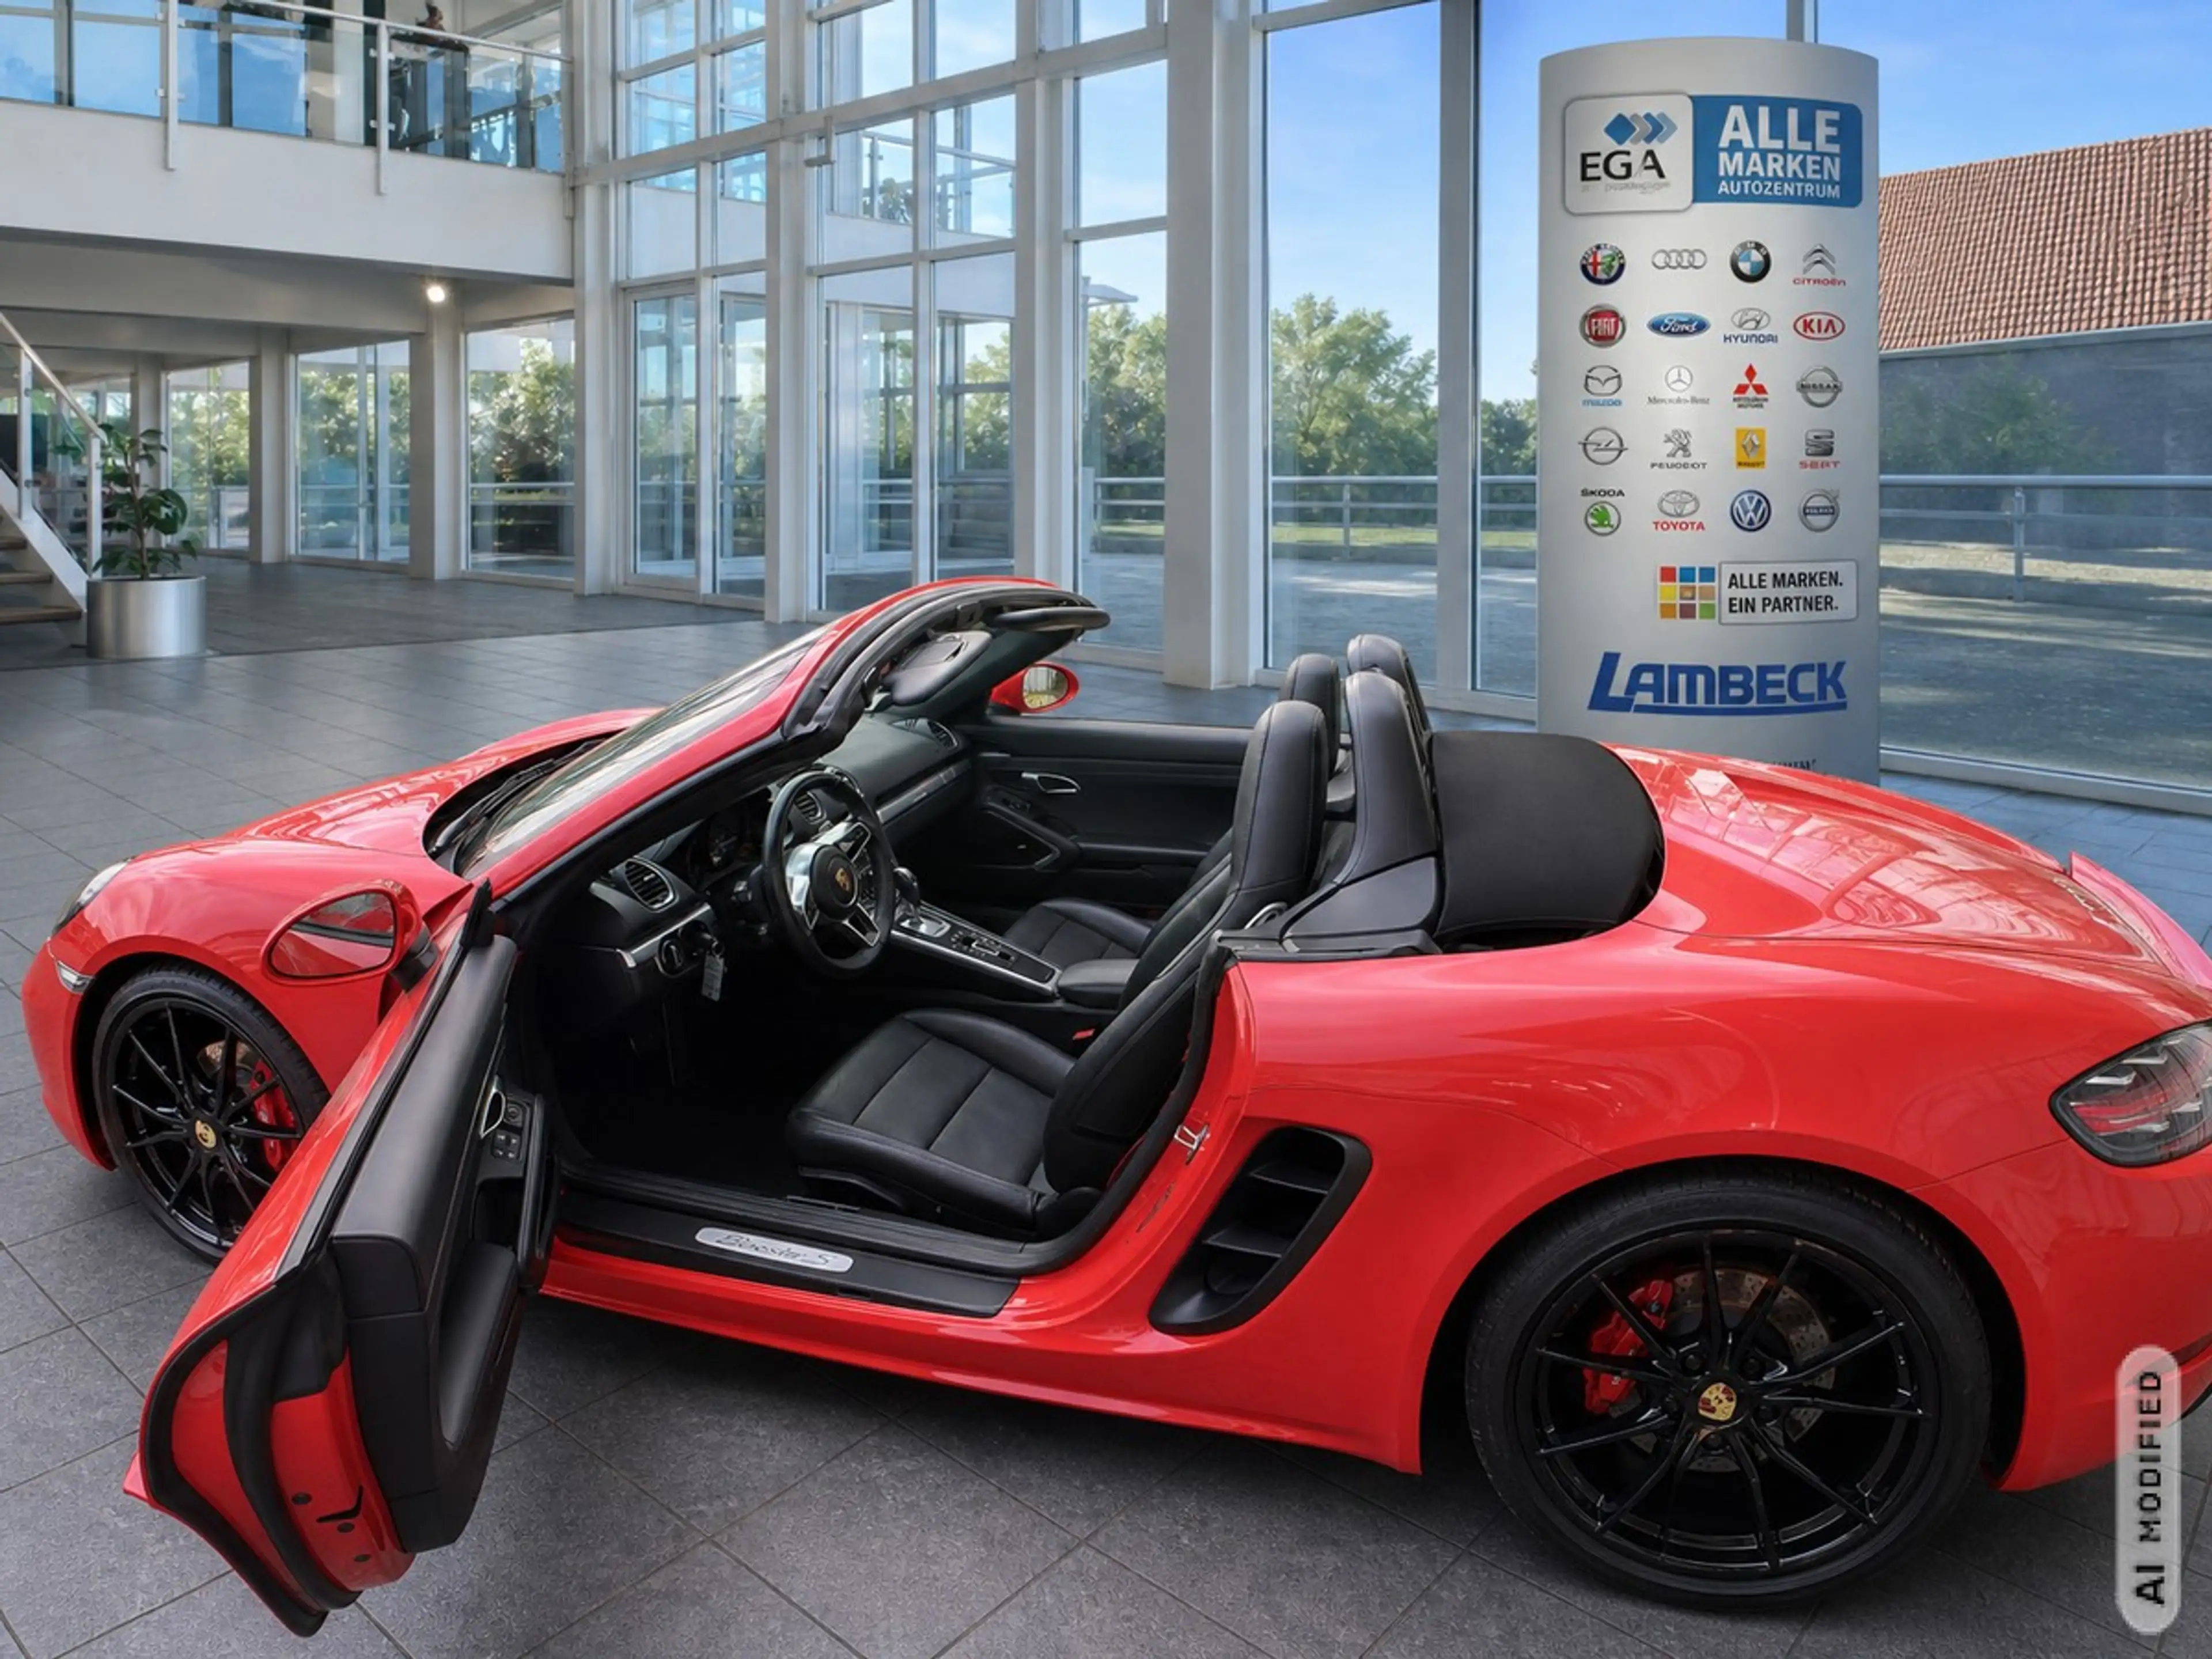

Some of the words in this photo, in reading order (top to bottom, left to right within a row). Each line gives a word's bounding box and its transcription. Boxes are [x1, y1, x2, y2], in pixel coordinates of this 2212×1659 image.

[1718, 104, 1841, 153] ALLE
[1580, 149, 1666, 181] EGA
[1718, 151, 1840, 181] MARKEN
[1718, 180, 1840, 199] AUTOZENTRUM
[1591, 318, 1616, 336] FIAT
[1660, 315, 1698, 333] Ford
[1724, 334, 1778, 343] HYUNDAI
[1652, 521, 1706, 531] TOYOTA
[1728, 573, 1767, 589] ALLE
[1772, 571, 1843, 589] MARKEN.
[1729, 597, 1756, 613] EIN
[1762, 595, 1839, 613] PARTNER.
[1588, 652, 1848, 713] LAMBECK
